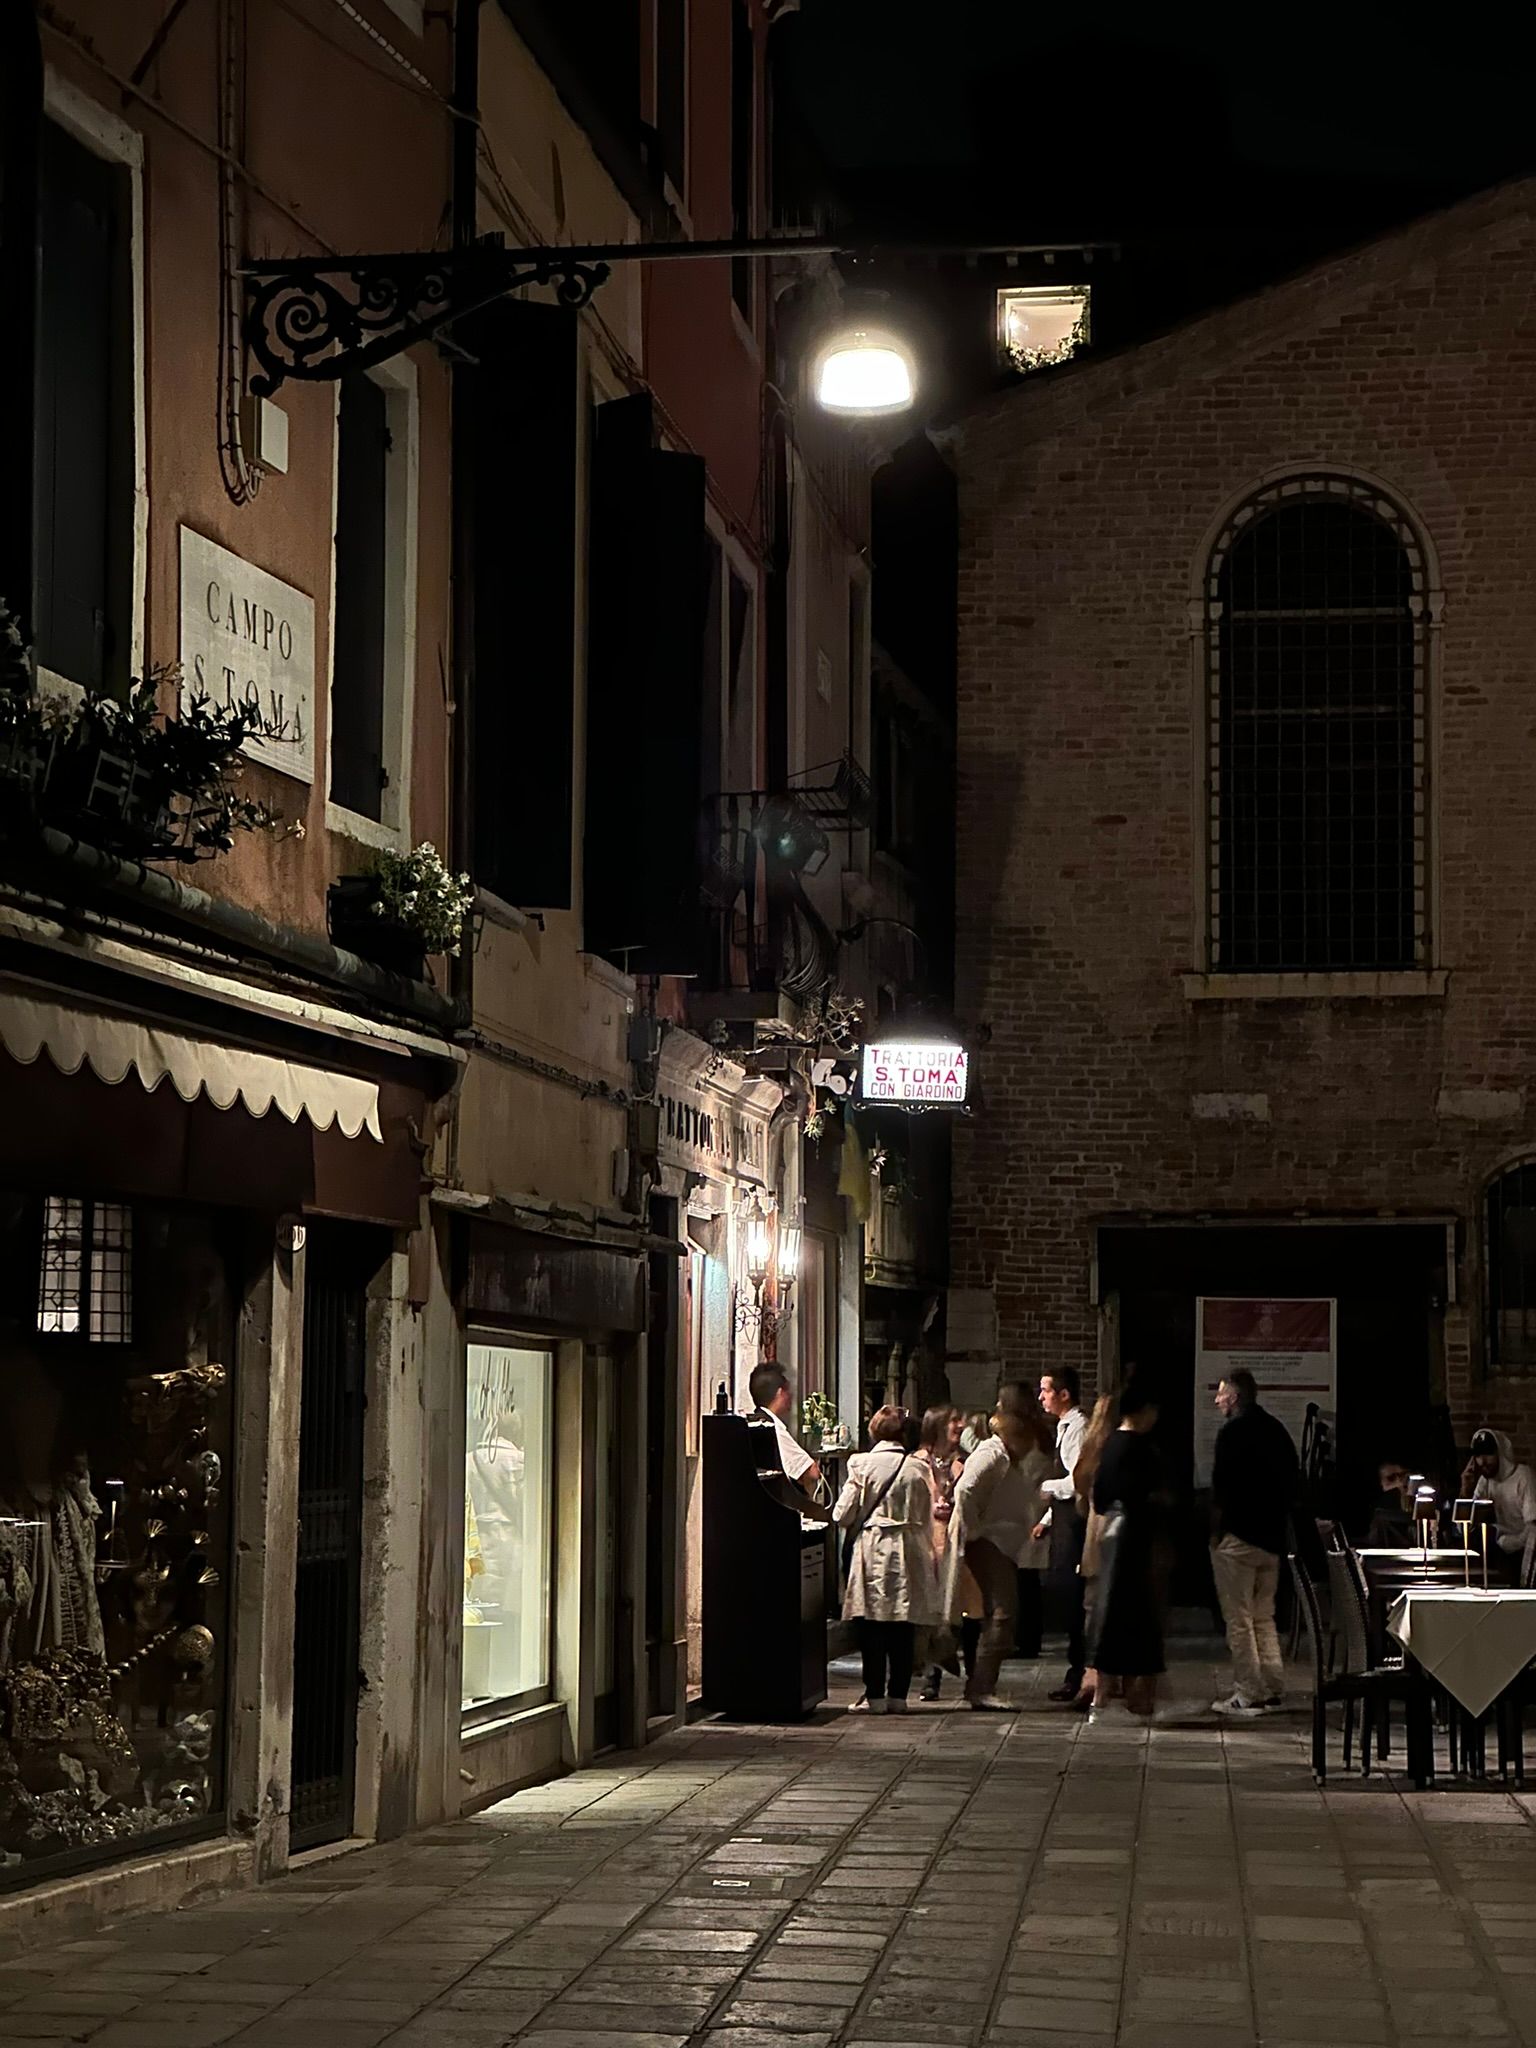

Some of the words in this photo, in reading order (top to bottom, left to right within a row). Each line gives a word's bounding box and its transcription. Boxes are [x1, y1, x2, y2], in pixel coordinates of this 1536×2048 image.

[206, 581, 292, 660] CAMPO
[871, 1049, 965, 1068] TRATTORIA
[870, 1082, 895, 1096] CON
[904, 1084, 963, 1099] GIARDINO
